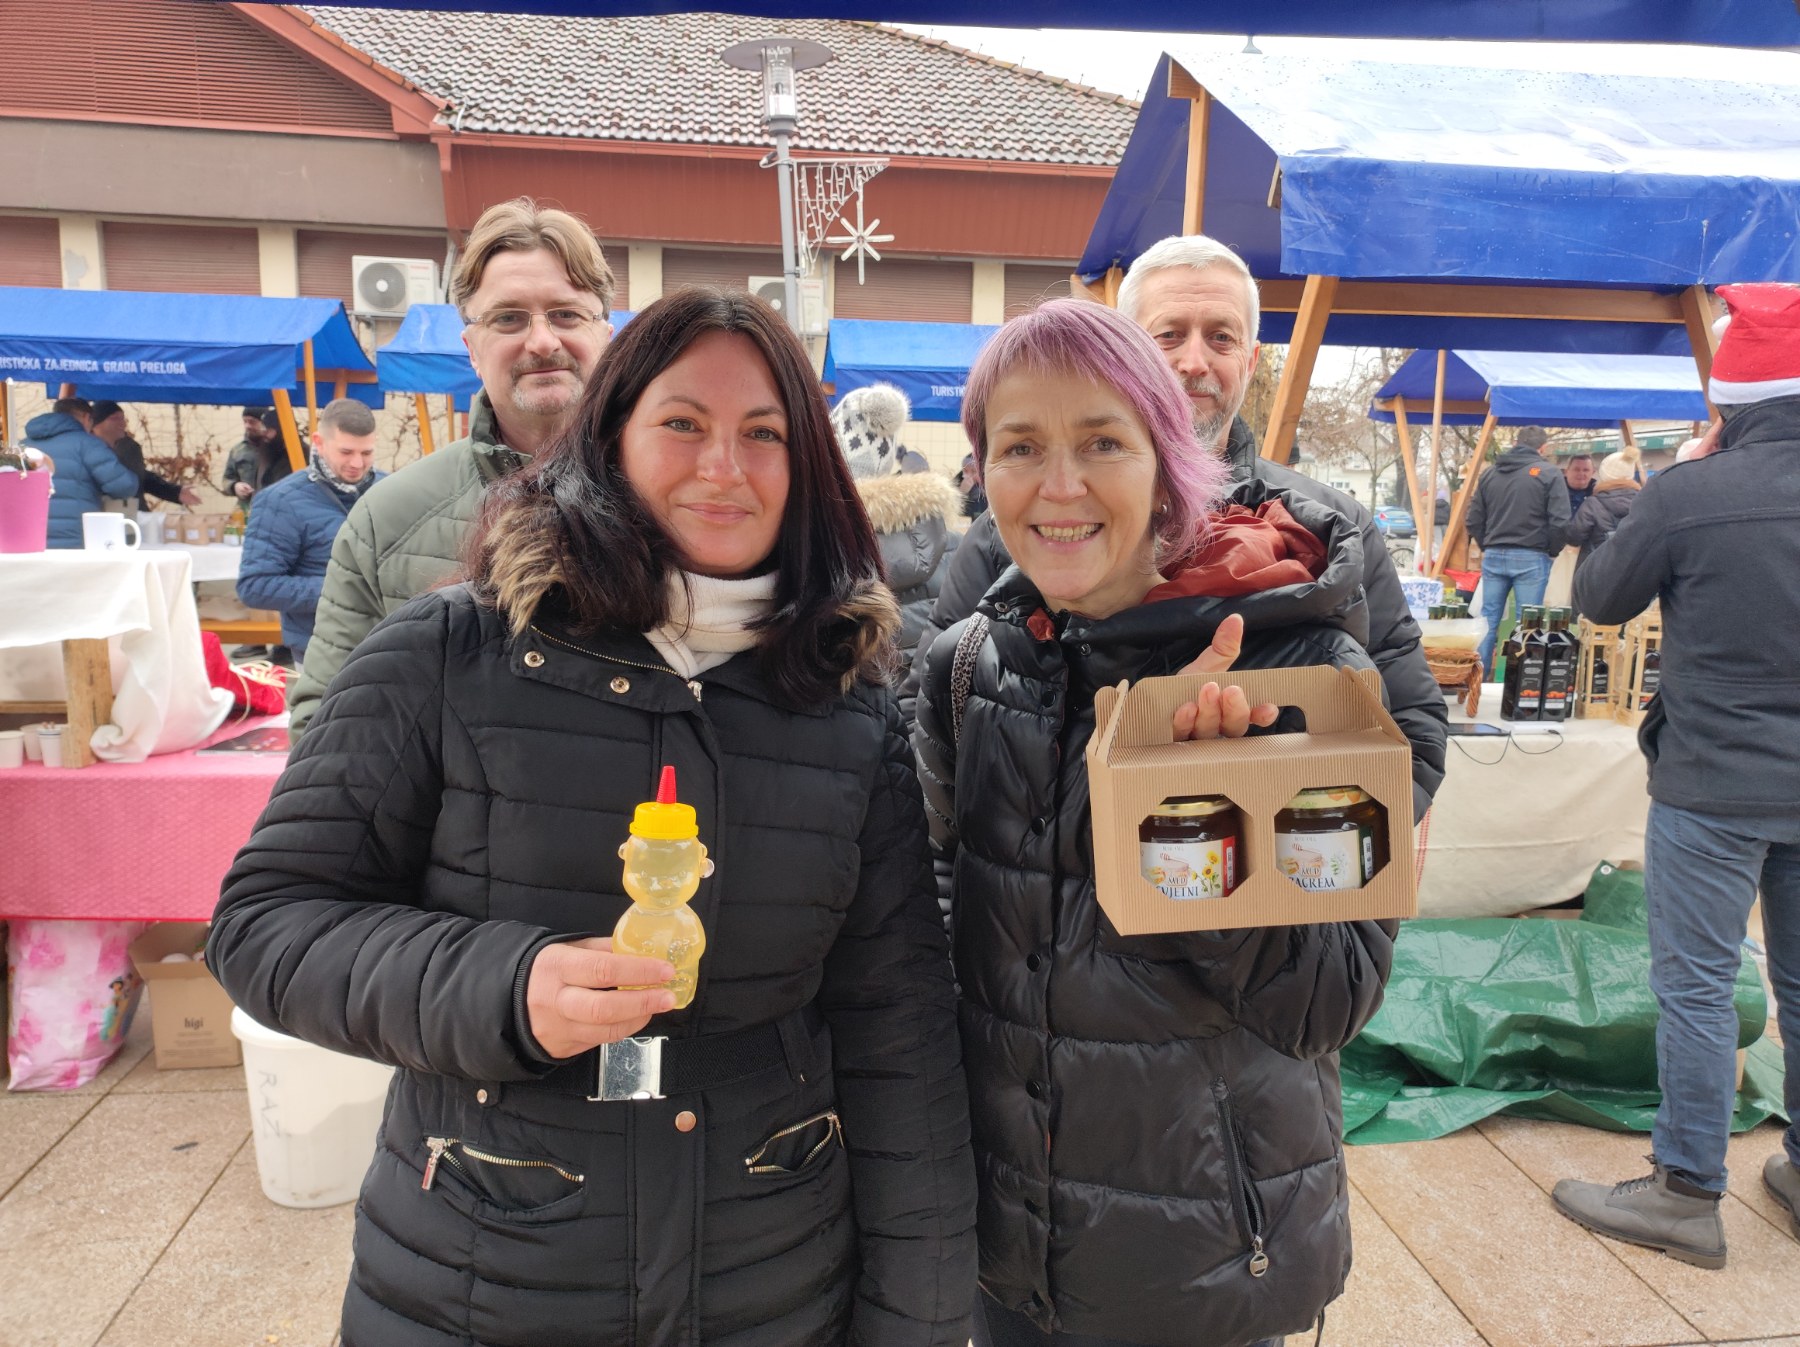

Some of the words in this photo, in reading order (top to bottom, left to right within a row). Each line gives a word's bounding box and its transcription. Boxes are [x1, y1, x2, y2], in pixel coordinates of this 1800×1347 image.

[44, 358, 99, 373] ZAJEDNICA
[103, 361, 138, 373] GRADA
[140, 361, 187, 375] PRELOGA
[1156, 885, 1199, 898] VJETNI
